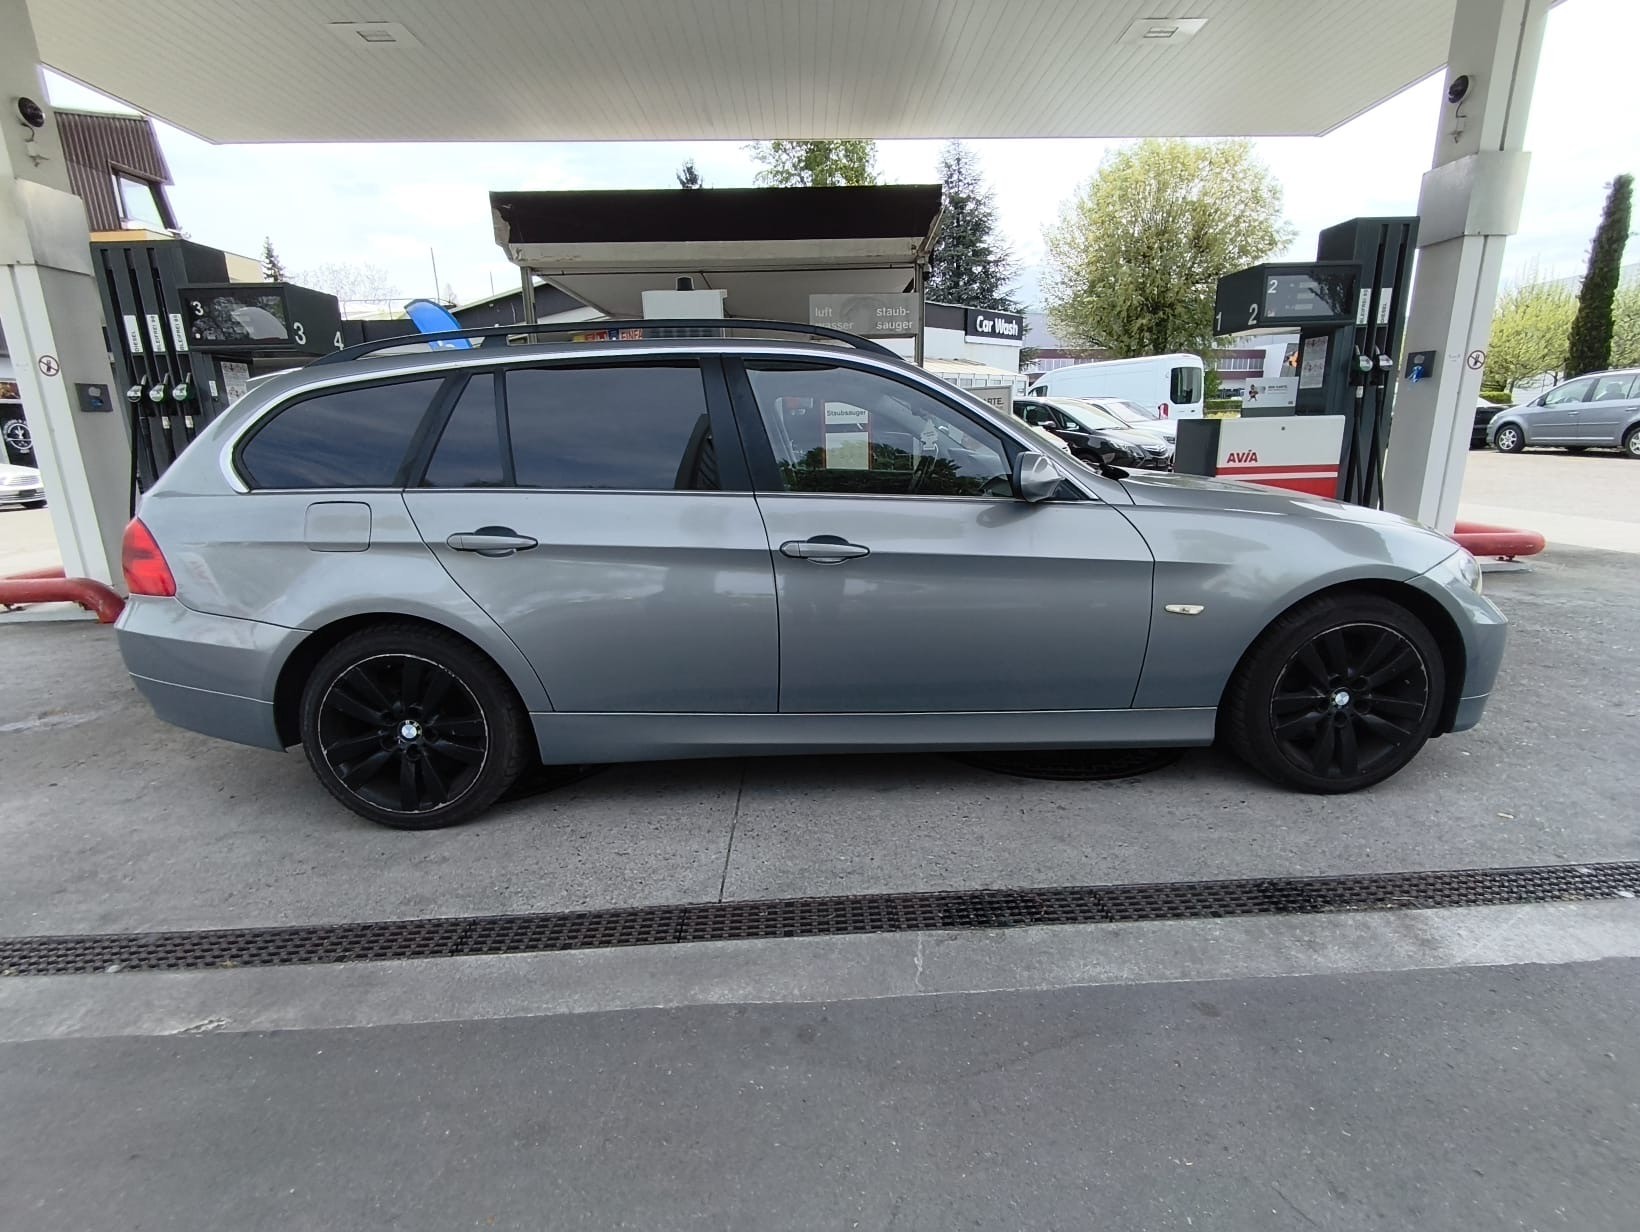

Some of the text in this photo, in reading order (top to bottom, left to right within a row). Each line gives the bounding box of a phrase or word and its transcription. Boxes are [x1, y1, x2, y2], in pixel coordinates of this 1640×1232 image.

[1267, 279, 1278, 293] 2
[192, 301, 204, 315] 3
[815, 307, 833, 317] luft
[876, 306, 911, 317] staub-
[1247, 303, 1259, 326] 2
[876, 320, 913, 331] sauger
[976, 315, 1019, 336] Car Wash
[1215, 311, 1222, 331] 1
[293, 322, 306, 345] 3
[333, 331, 345, 350] 4
